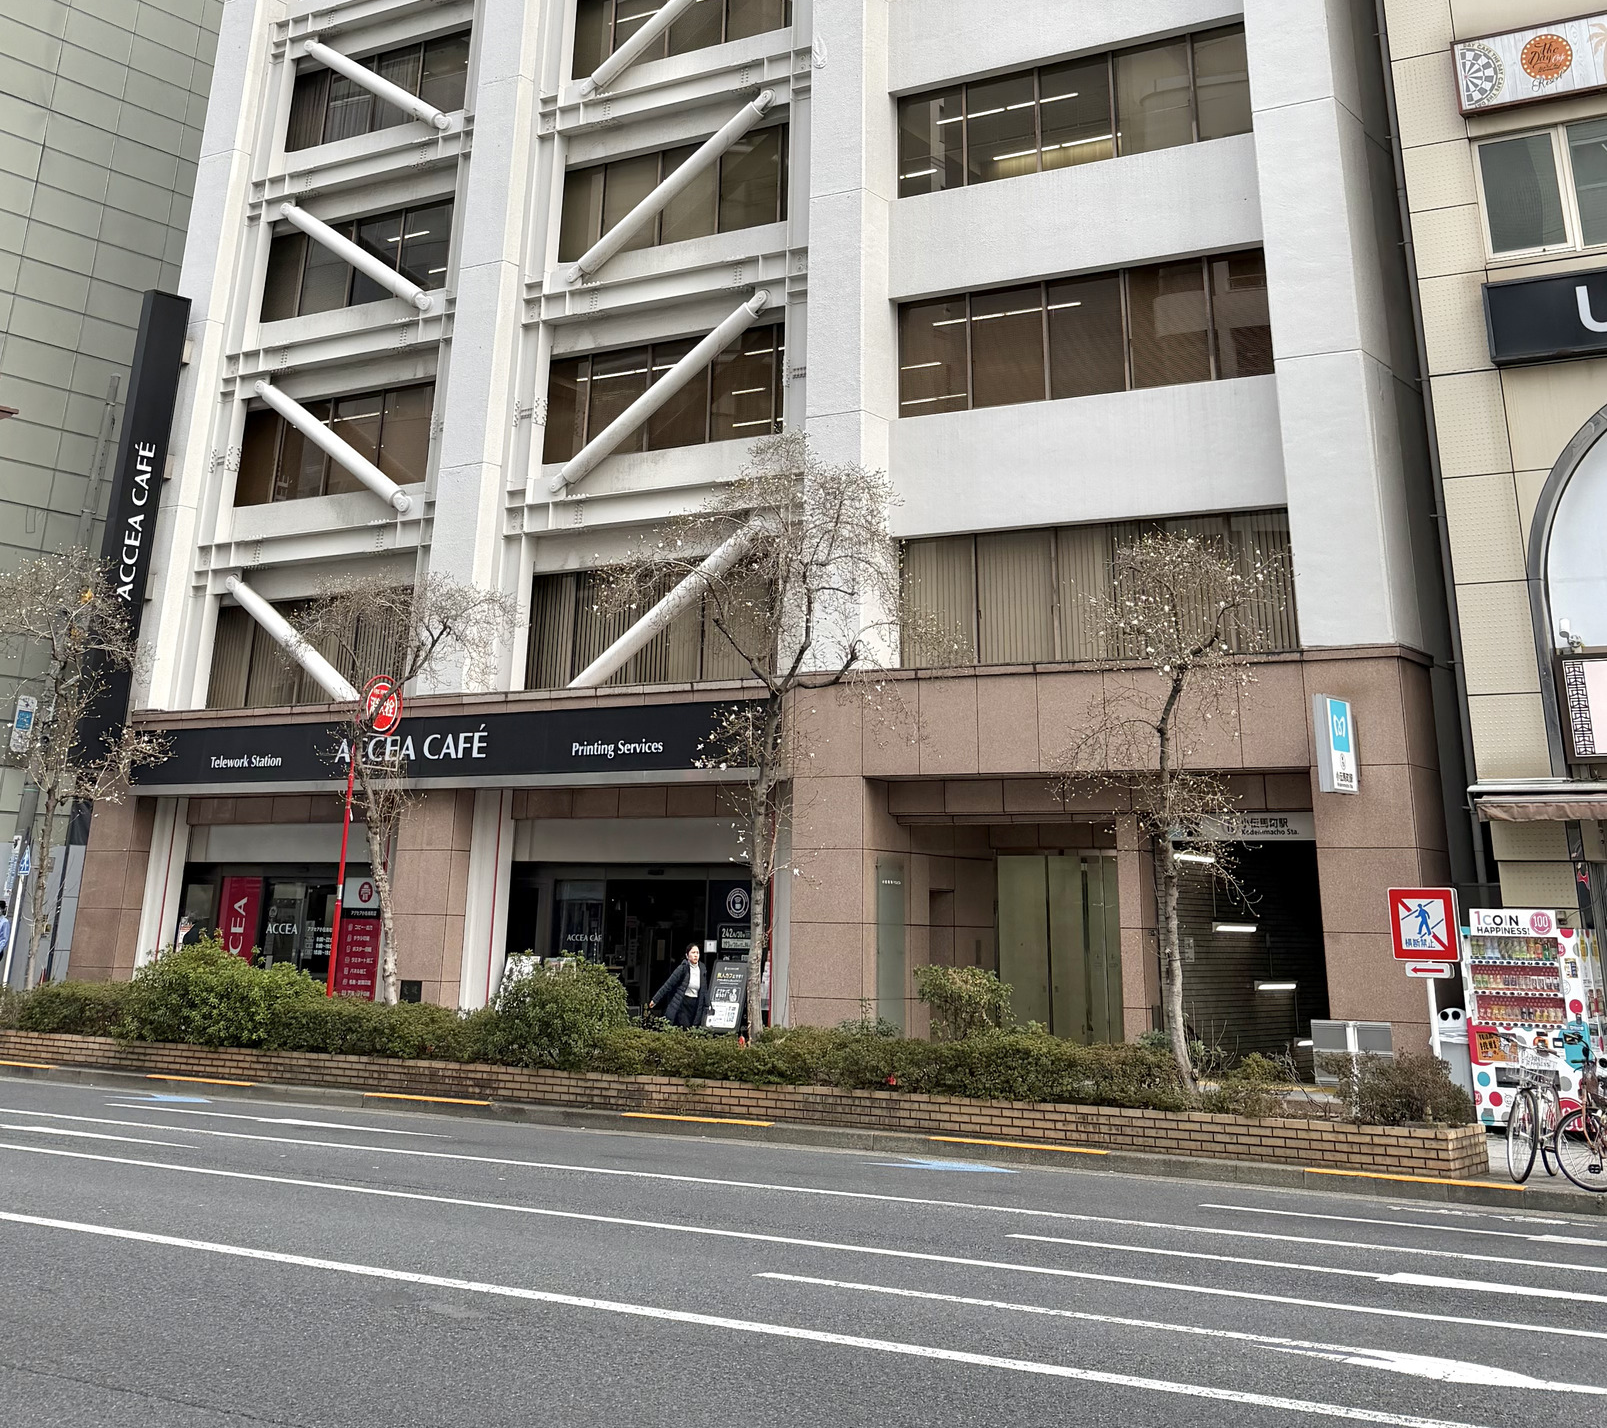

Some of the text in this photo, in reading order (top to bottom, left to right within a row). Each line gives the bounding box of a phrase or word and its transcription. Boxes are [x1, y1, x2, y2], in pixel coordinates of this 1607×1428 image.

[117, 441, 156, 601] ACCEA CAFÉ
[423, 723, 488, 760] CAFÉ
[572, 738, 664, 759] Printing Services
[210, 753, 282, 769] Telework Station
[266, 923, 298, 935] ACCEA
[1532, 915, 1549, 928] 100
[1476, 926, 1531, 936] HAPPINESS!
